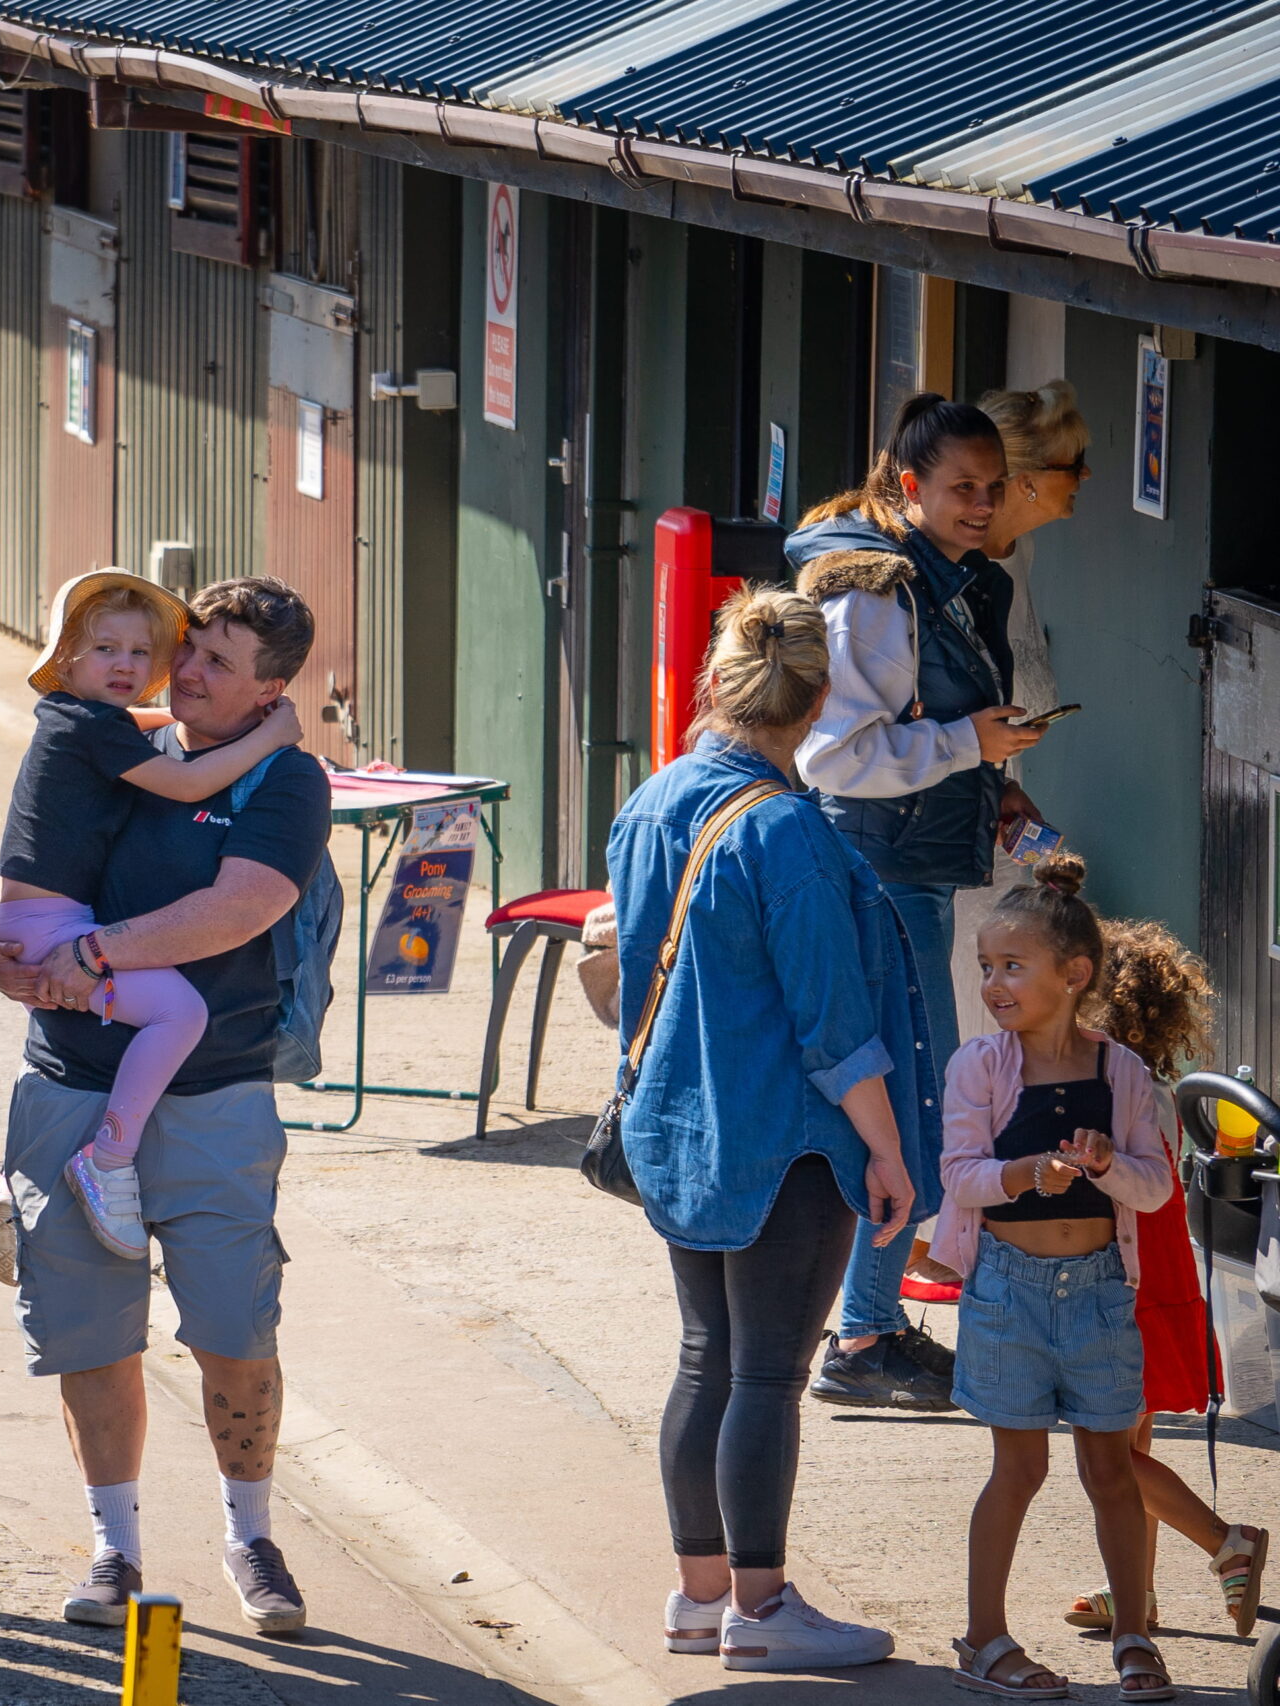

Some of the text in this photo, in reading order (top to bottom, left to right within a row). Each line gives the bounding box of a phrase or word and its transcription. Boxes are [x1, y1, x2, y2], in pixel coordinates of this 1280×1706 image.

[209, 815, 232, 826] berg
[421, 860, 447, 878] Pony
[403, 884, 454, 900] Grooming
[395, 976, 408, 985] per
[408, 975, 432, 985] person
